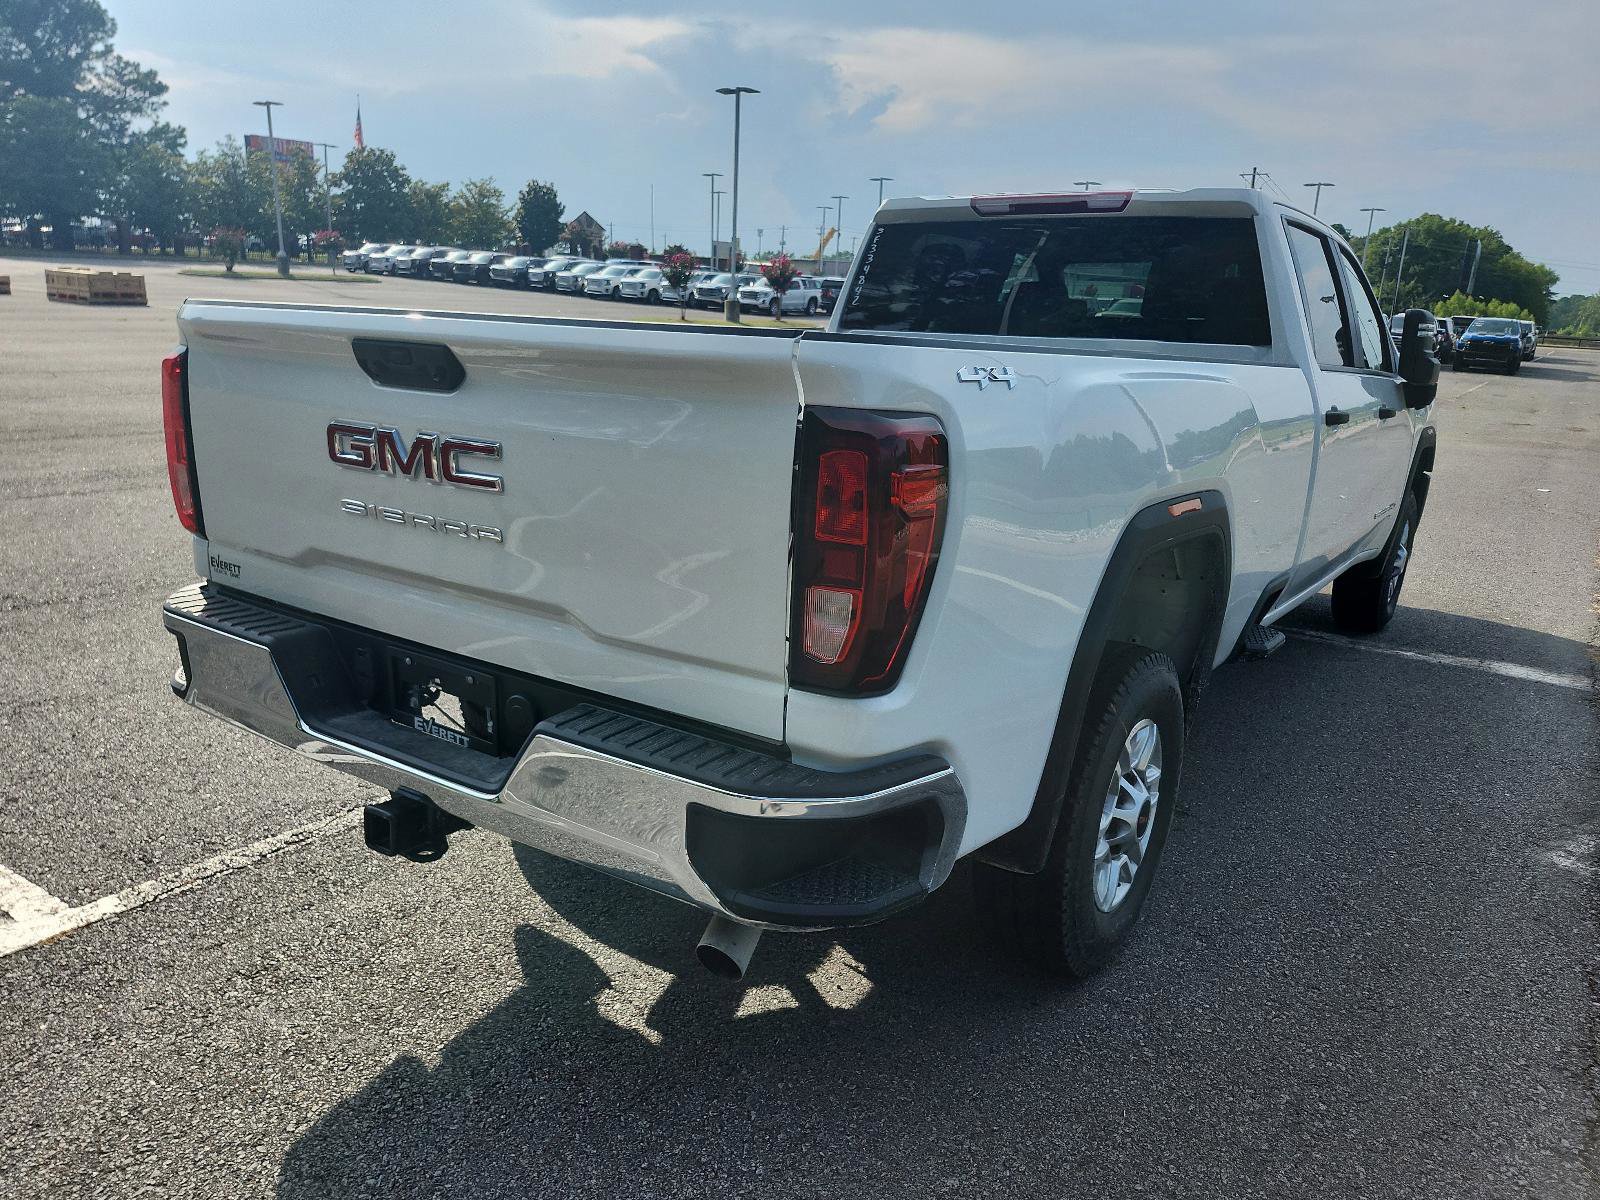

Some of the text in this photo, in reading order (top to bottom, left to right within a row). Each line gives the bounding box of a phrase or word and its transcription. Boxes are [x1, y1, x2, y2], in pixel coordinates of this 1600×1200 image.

[327, 418, 504, 493] GMC
[340, 498, 504, 543] SIERRA
[210, 555, 241, 574] EVERETT
[414, 716, 470, 748] EVERETT
